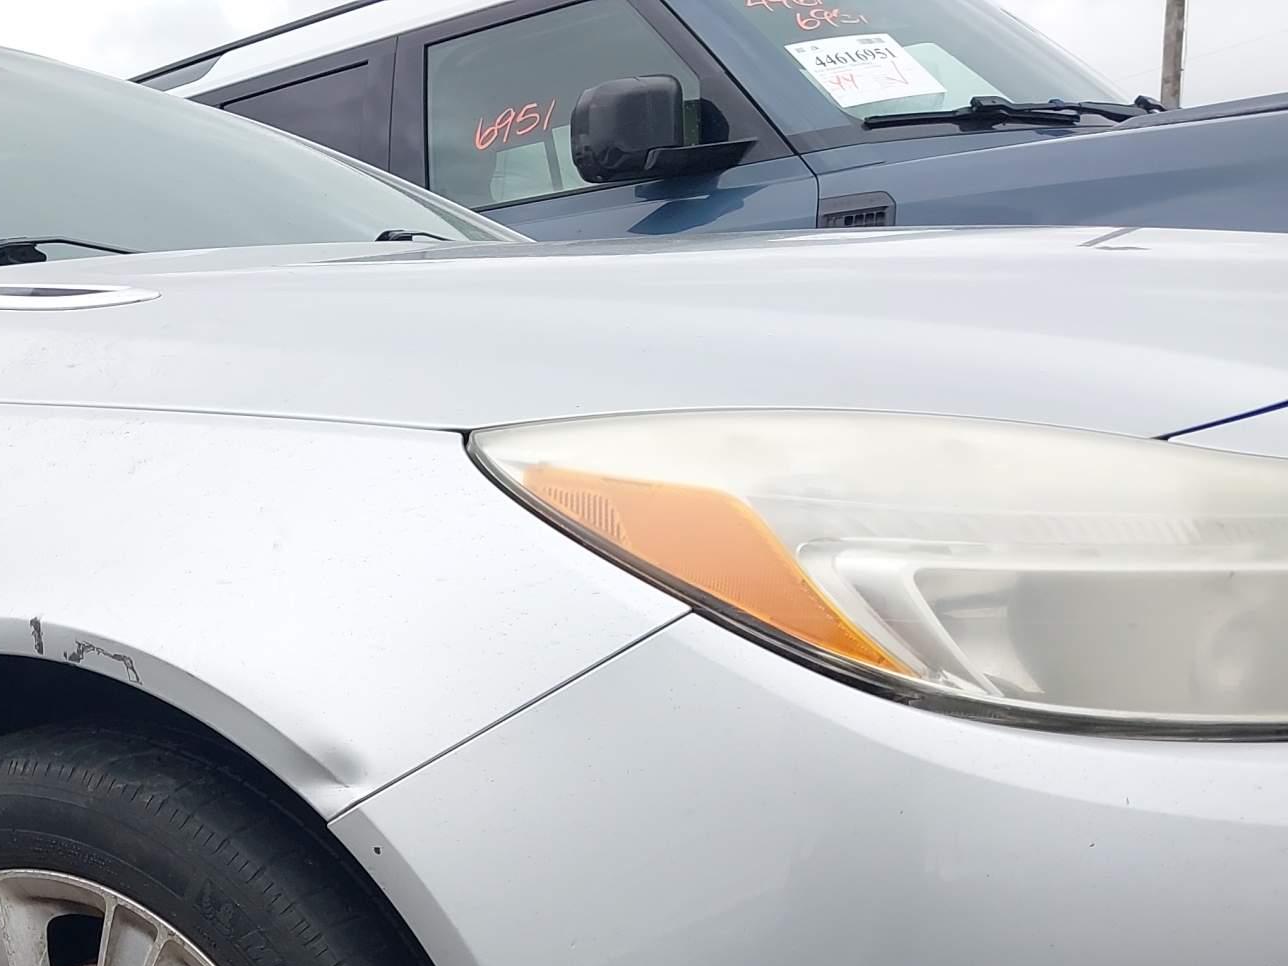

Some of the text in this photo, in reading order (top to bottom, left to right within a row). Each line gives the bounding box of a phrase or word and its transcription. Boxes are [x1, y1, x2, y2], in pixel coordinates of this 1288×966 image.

[796, 8, 869, 30] 6951
[815, 47, 897, 67] 44616951
[475, 98, 556, 150] 6951
